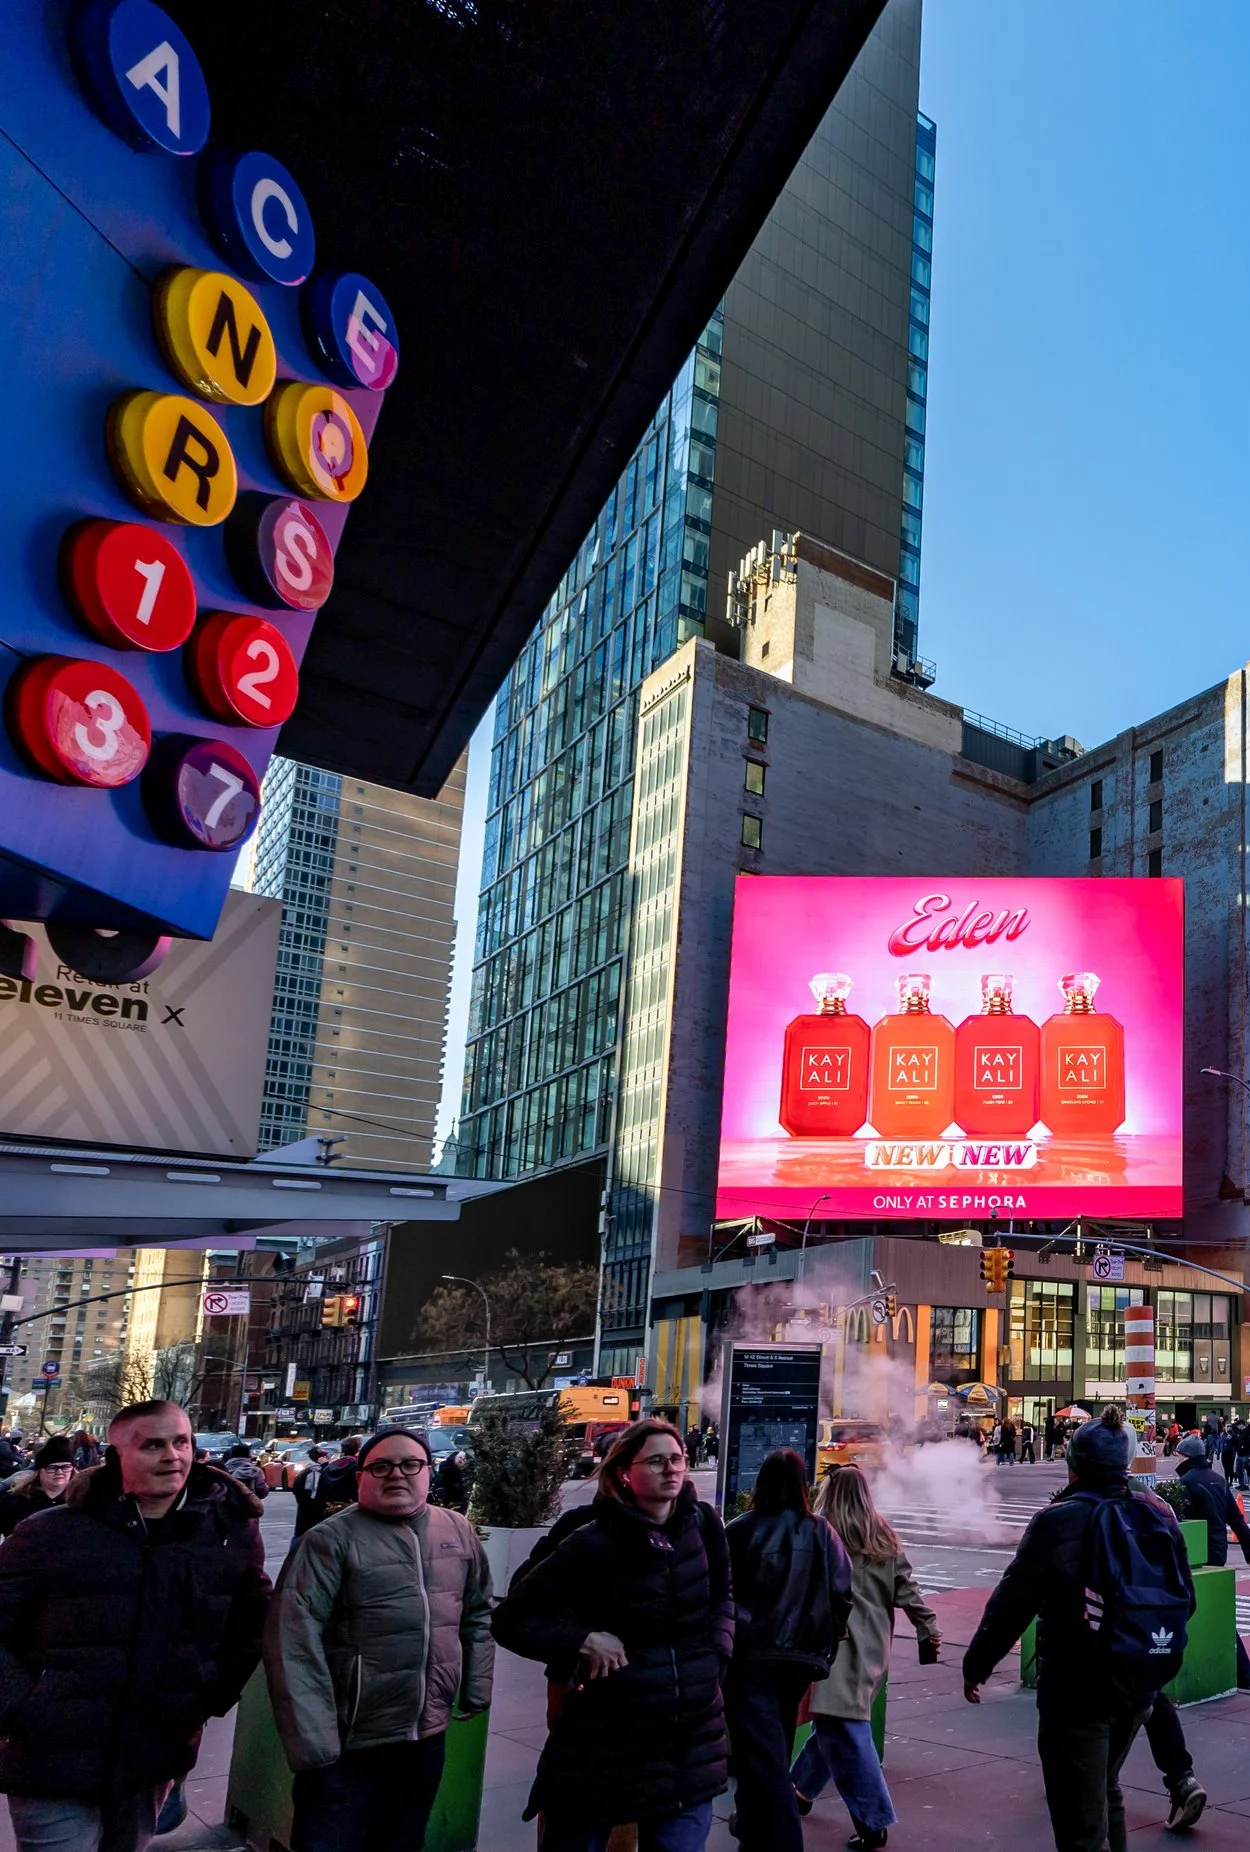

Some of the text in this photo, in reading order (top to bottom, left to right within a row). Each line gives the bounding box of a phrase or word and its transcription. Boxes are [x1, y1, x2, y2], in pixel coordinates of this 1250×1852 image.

[126, 41, 388, 374] A C E
[205, 290, 354, 491] N Q
[163, 413, 317, 591] R S
[134, 559, 280, 710] 1 2
[75, 690, 243, 829] 3 7
[887, 893, 1032, 957] Eden
[129, 979, 149, 994] at
[67, 1013, 100, 1026] TIMES
[103, 1019, 147, 1033] SQUARE
[809, 1054, 845, 1066] KAY
[896, 1054, 932, 1066] KAY
[981, 1053, 1017, 1066] KAY
[1065, 1053, 1100, 1065] KAY
[808, 1070, 841, 1083] ALI
[896, 1070, 928, 1083] ALI
[981, 1069, 1013, 1082] ALI
[1065, 1069, 1097, 1082] ALI
[871, 1144, 1033, 1166] NEW NEW
[873, 1195, 1027, 1209] ONLY AT SEPHORA
